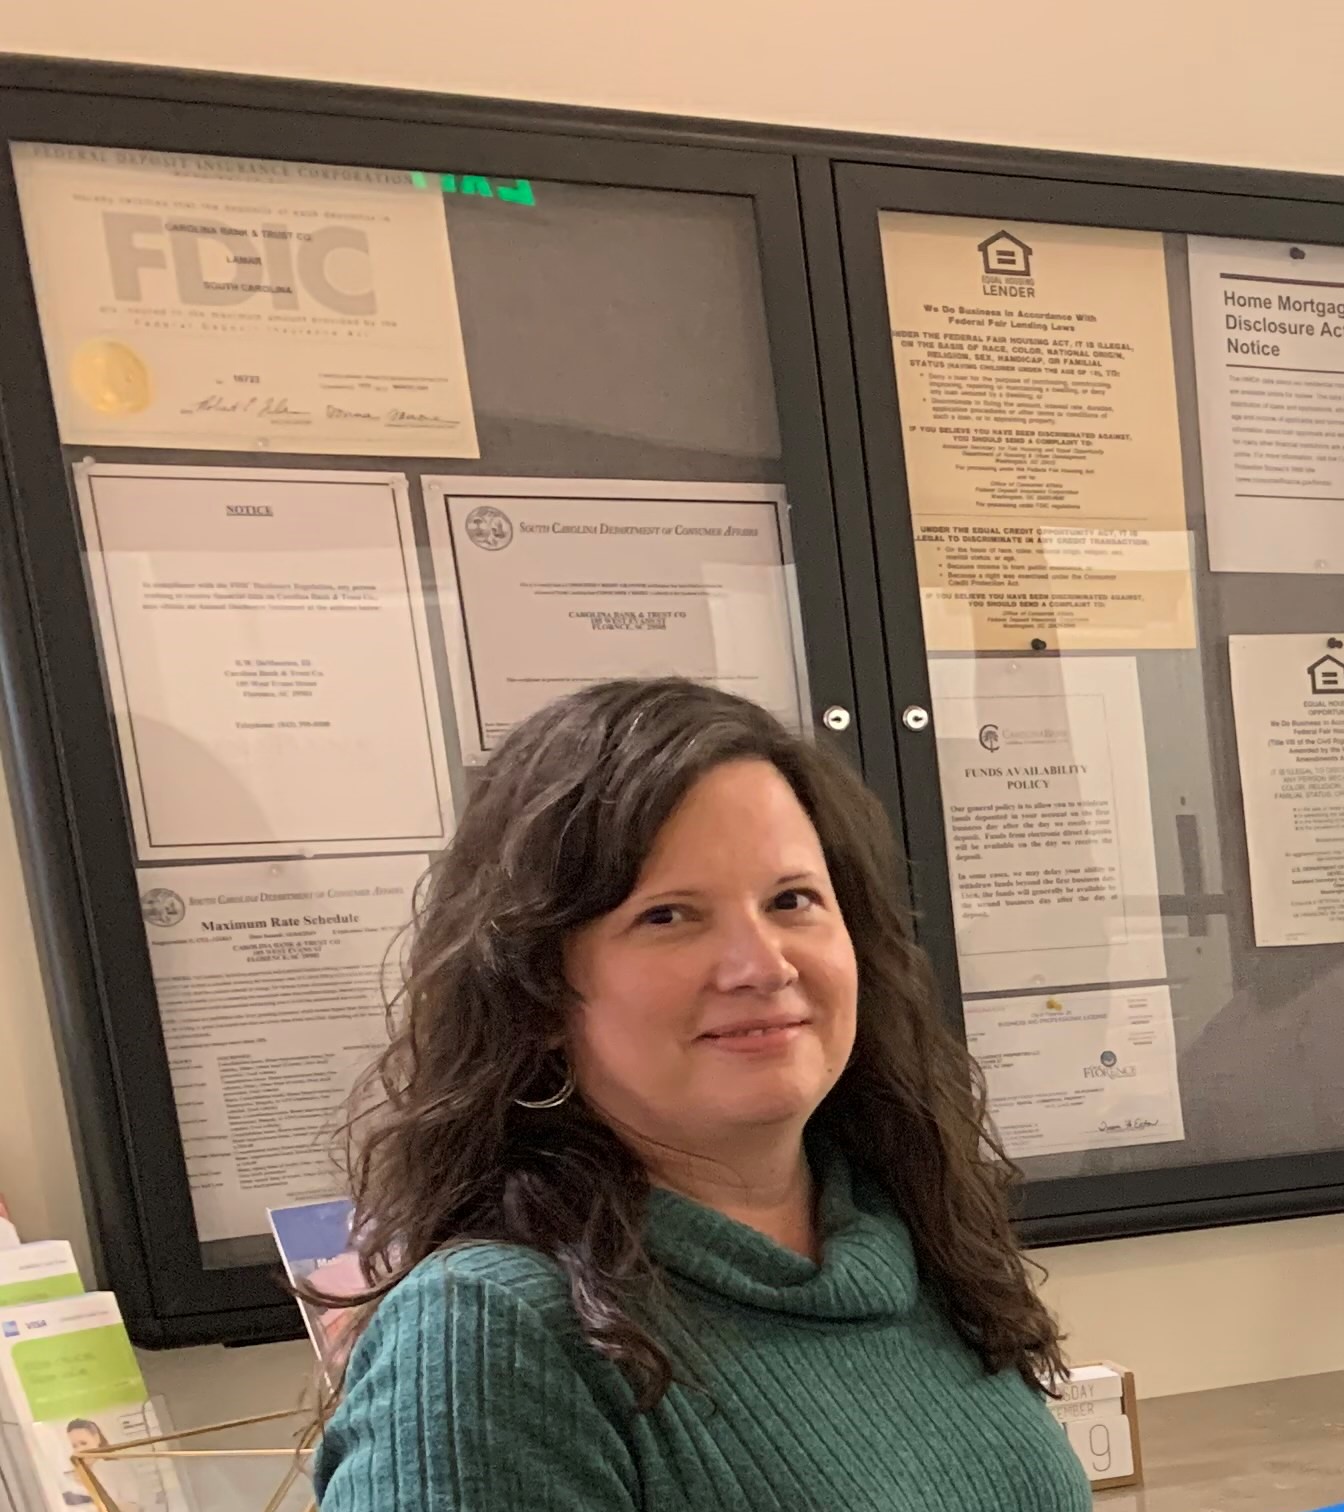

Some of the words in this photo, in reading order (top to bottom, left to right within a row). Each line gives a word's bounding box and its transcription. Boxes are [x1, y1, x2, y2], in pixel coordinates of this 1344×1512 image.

[32, 146, 106, 163] FEDERAL
[116, 152, 188, 170] DEPOSIT
[197, 158, 289, 177] INSURANCE
[297, 165, 414, 186] CORPORATION
[164, 223, 218, 236] CAROLINA
[261, 230, 293, 240] TRUST
[101, 210, 377, 316] FDIC
[225, 255, 263, 266] LAMAR
[202, 281, 239, 292] SOUTH
[241, 283, 293, 295] CAROLINA
[983, 284, 1036, 298] LENDER
[1224, 290, 1272, 309] Home
[923, 304, 939, 313] We
[942, 306, 955, 314] Do
[959, 306, 1001, 316] Business
[1017, 310, 1072, 321] Accordance
[1075, 314, 1097, 323] With
[948, 317, 985, 326] Federal
[988, 318, 1007, 327] Fair
[1010, 320, 1048, 331] Lending
[1051, 323, 1075, 332] Laws
[1225, 314, 1315, 336] Disclosure
[944, 332, 983, 342] FEDERAL
[986, 335, 1007, 343] FAIR
[1010, 337, 1049, 345] HOUSING
[938, 342, 964, 350] BASIS
[967, 343, 979, 351] OF
[1047, 347, 1090, 358] NATIONAL
[1227, 337, 1281, 357] Notice
[909, 360, 945, 368] STATUS
[1048, 357, 1061, 365] OR
[1063, 358, 1102, 367] FAMILIAL
[226, 505, 273, 516] NOTICE
[920, 526, 950, 534] UNDER
[972, 527, 1001, 535] EQUAL
[1003, 528, 1033, 536] CREDIT
[1037, 528, 1095, 537] OPPORTUNITY
[915, 535, 945, 543] LEGAL
[962, 535, 1022, 544] DISCRIMINATE
[1057, 537, 1087, 545] CREDIT
[1303, 700, 1326, 708] EQUAL
[965, 767, 1003, 778] FUNDS
[1005, 764, 1088, 777] AVAILABILITY
[1007, 779, 1050, 790] POLICY
[201, 919, 267, 933] Maximum
[270, 917, 300, 928] Rate
[303, 913, 360, 926] Schedule
[1063, 1384, 1094, 1400] SDAY
[1057, 1402, 1094, 1419] EMBER
[1089, 1424, 1111, 1472] 9
